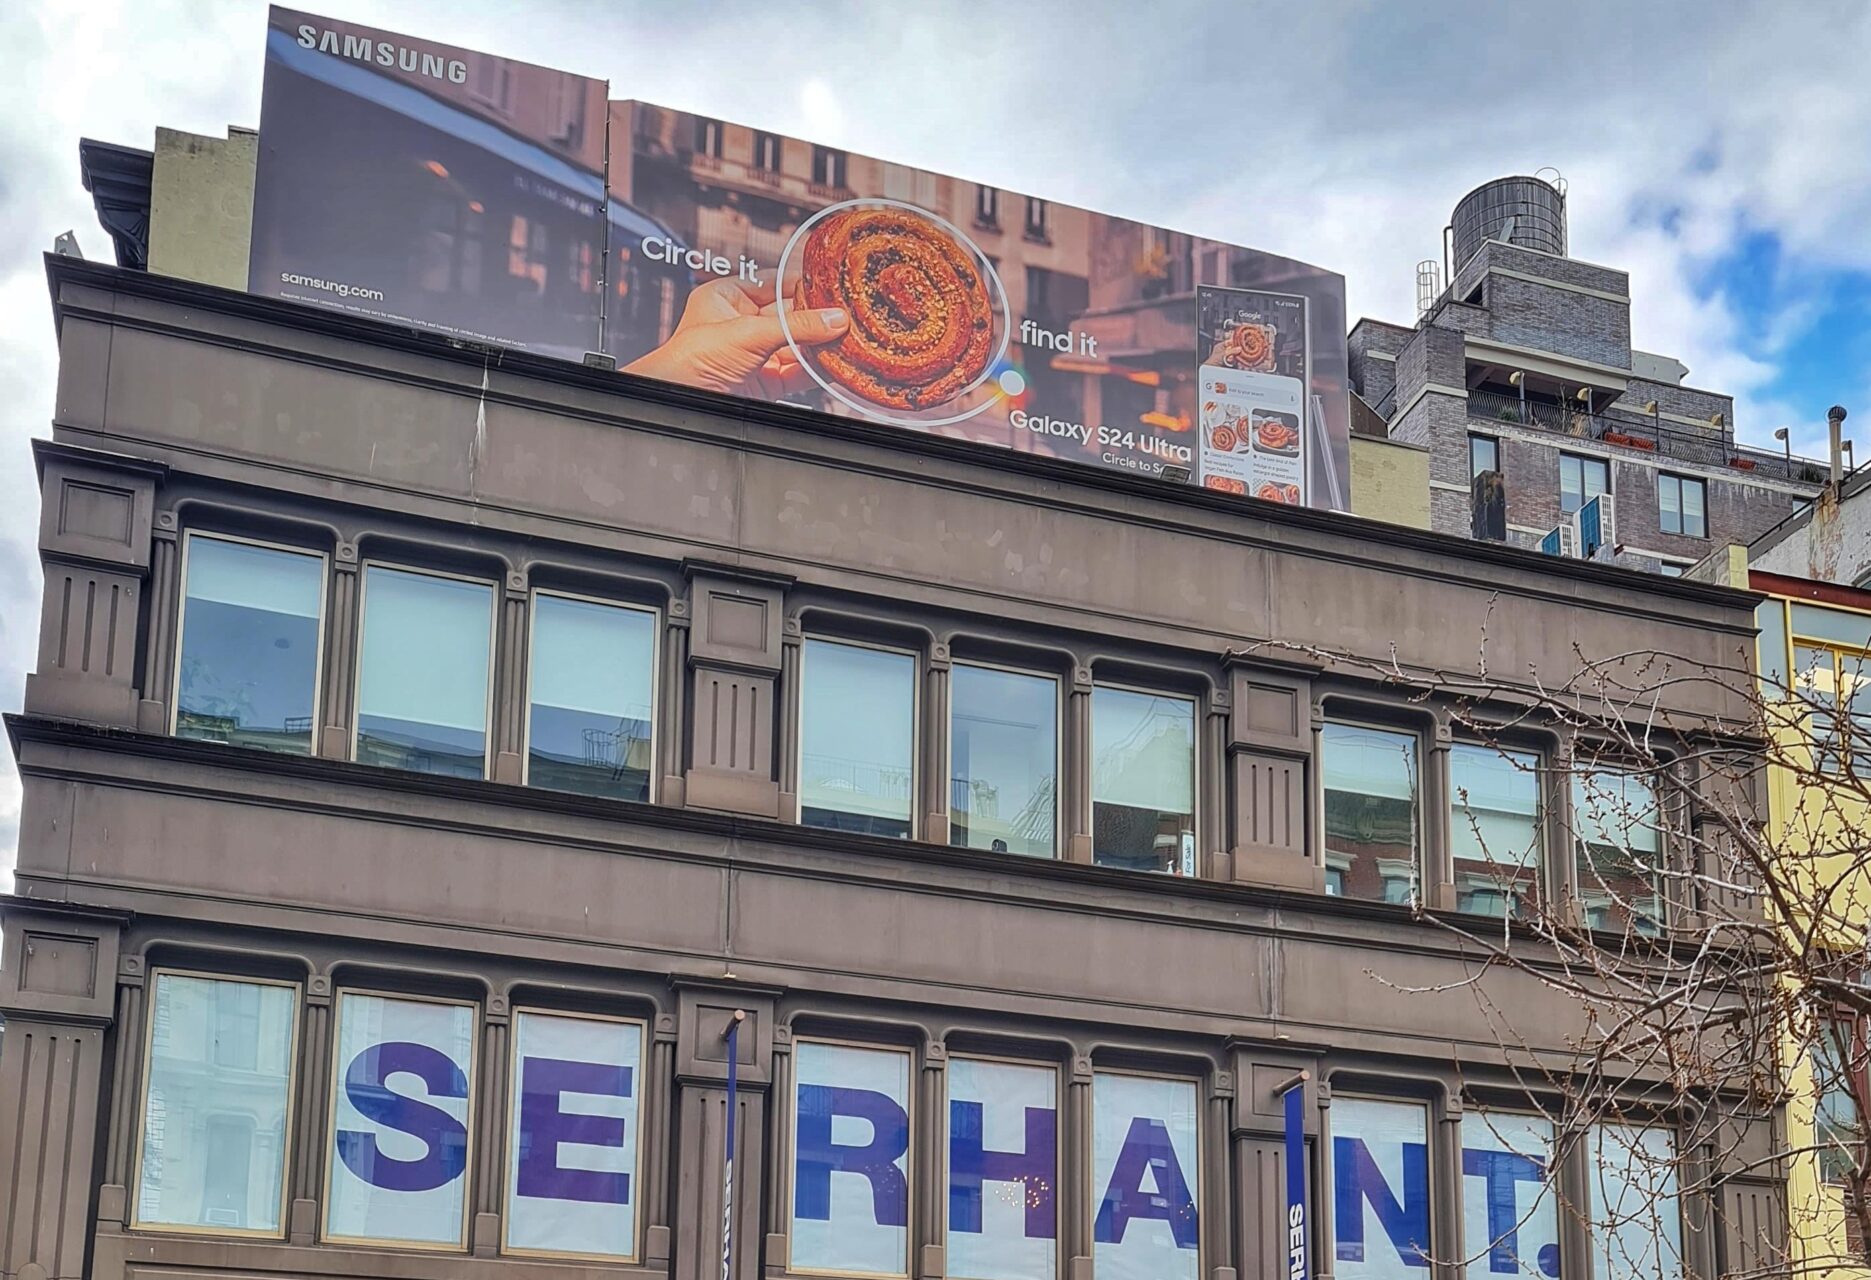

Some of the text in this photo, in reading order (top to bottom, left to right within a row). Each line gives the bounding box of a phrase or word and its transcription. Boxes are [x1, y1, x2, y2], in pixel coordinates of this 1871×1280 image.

[297, 24, 468, 85] SAMSUNG
[641, 235, 765, 288] Circle it,
[281, 272, 384, 301] samsung.com
[1238, 309, 1262, 321] Google
[1020, 319, 1098, 358] find it
[1009, 410, 1192, 462] Galaxy S24 Ultra
[1102, 452, 1137, 468] Circle
[1139, 460, 1151, 471] to
[336, 1041, 1560, 1278] SERHANT.
